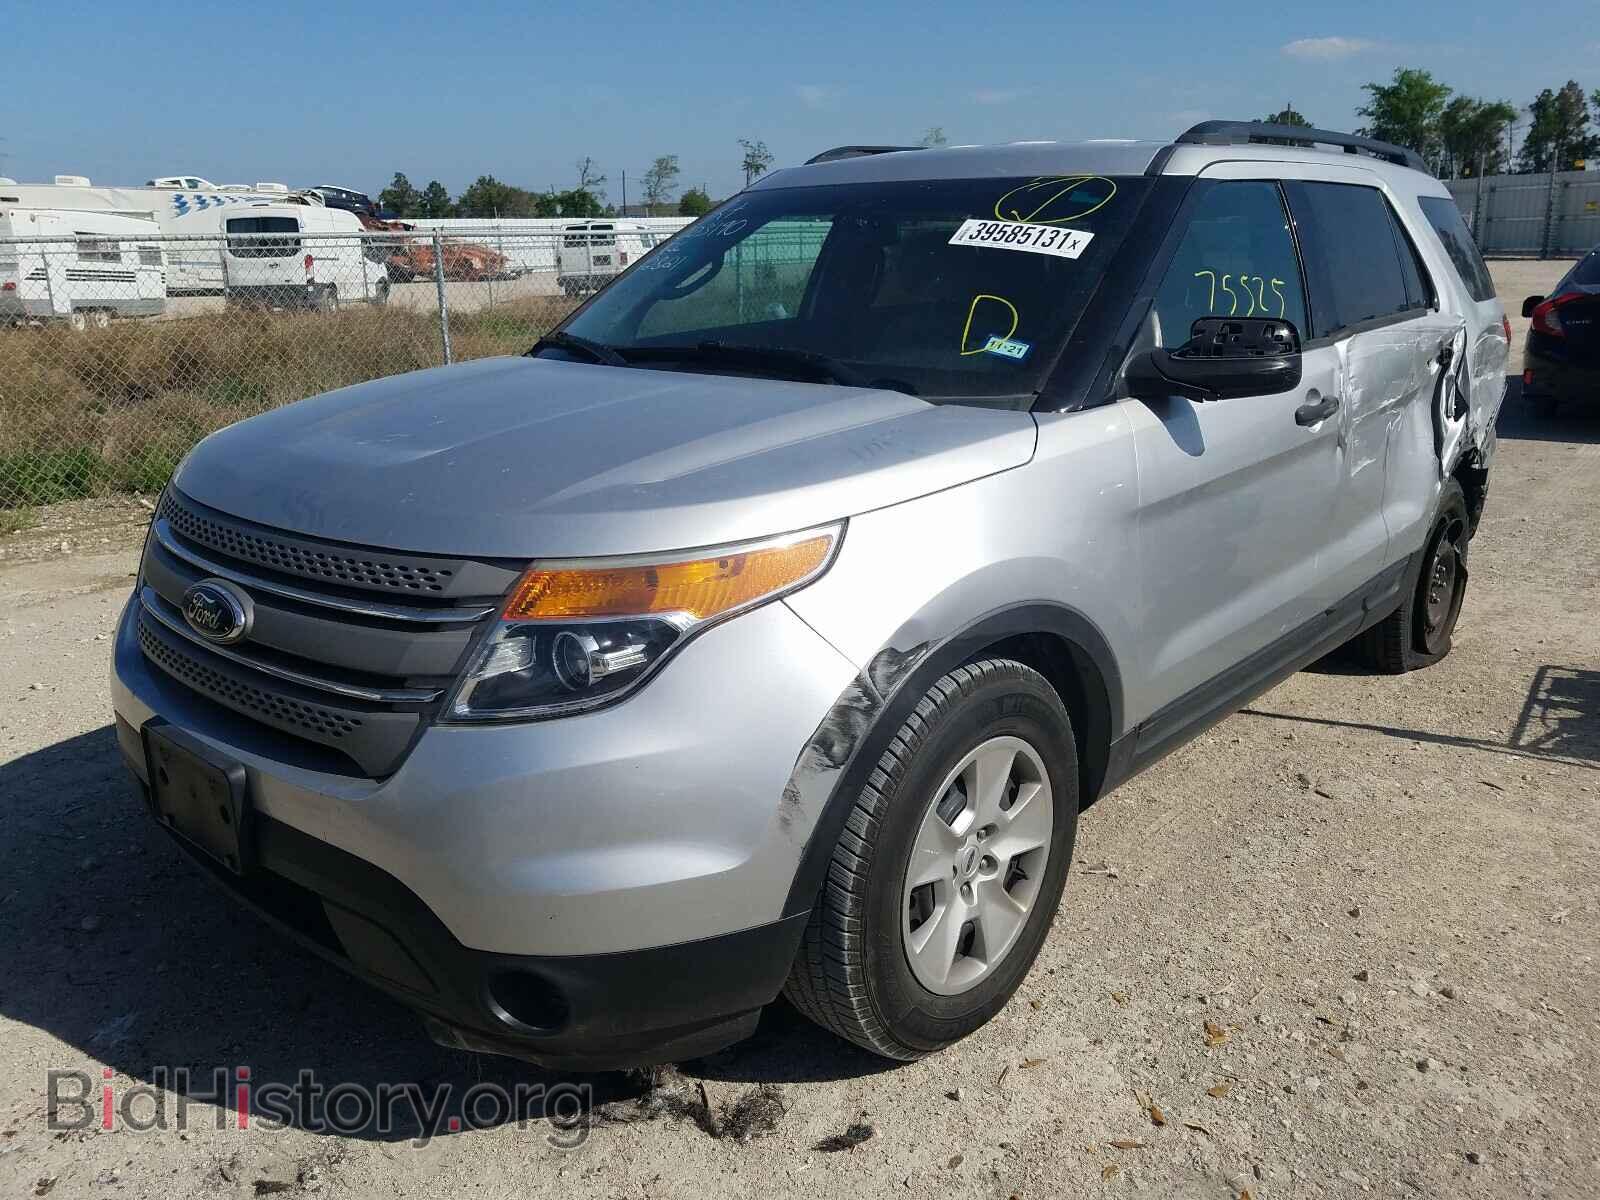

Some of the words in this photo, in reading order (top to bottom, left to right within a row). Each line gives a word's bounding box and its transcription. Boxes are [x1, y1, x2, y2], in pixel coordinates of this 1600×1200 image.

[968, 222, 1073, 250] 39585131
[959, 294, 1019, 356] D
[188, 591, 222, 630] Ford
